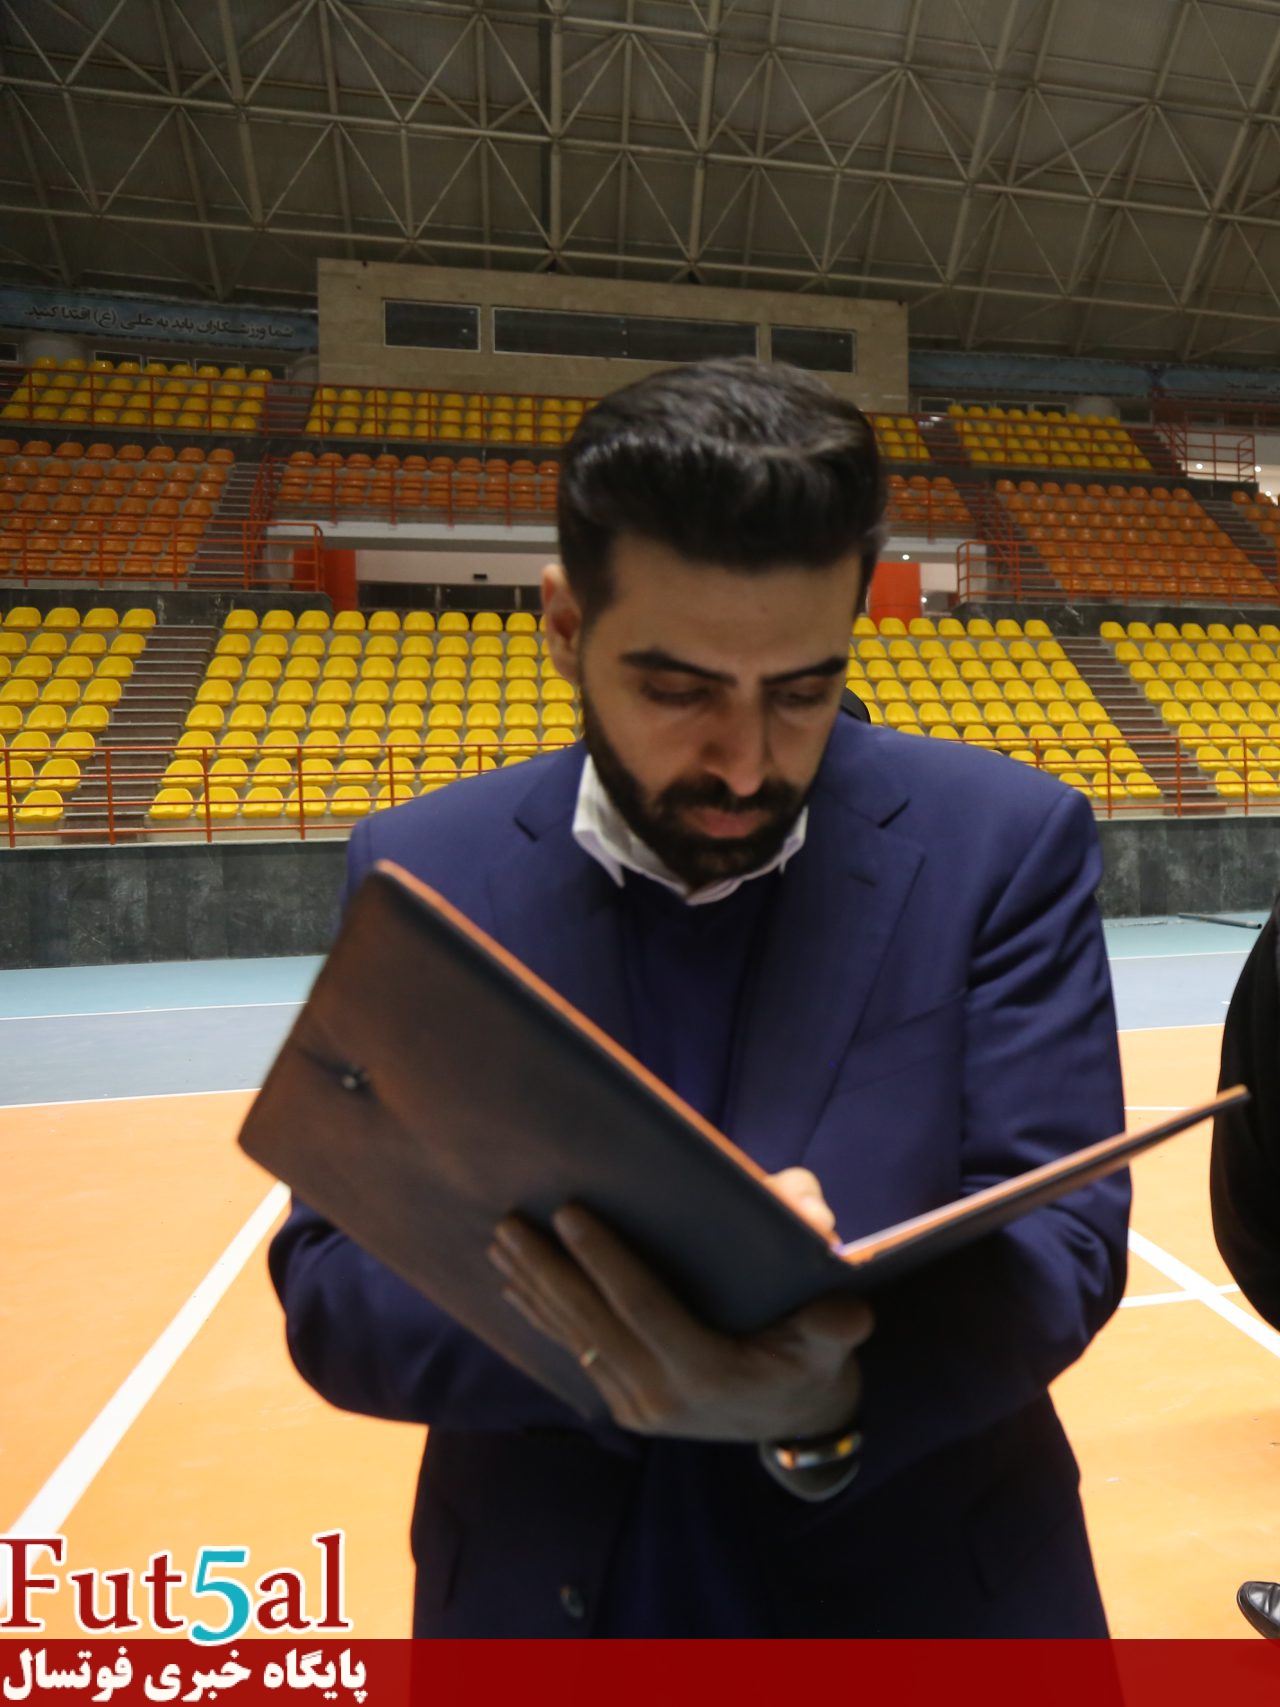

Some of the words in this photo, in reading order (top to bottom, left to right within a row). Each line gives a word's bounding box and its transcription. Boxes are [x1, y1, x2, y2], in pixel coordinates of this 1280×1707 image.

[62, 306, 91, 320] اقتدا
[94, 308, 117, 329] (ع)
[120, 313, 154, 330] علی
[157, 316, 169, 329] به
[171, 317, 194, 331] باید
[197, 319, 265, 340] ورزشکاران
[268, 323, 293, 338] شما
